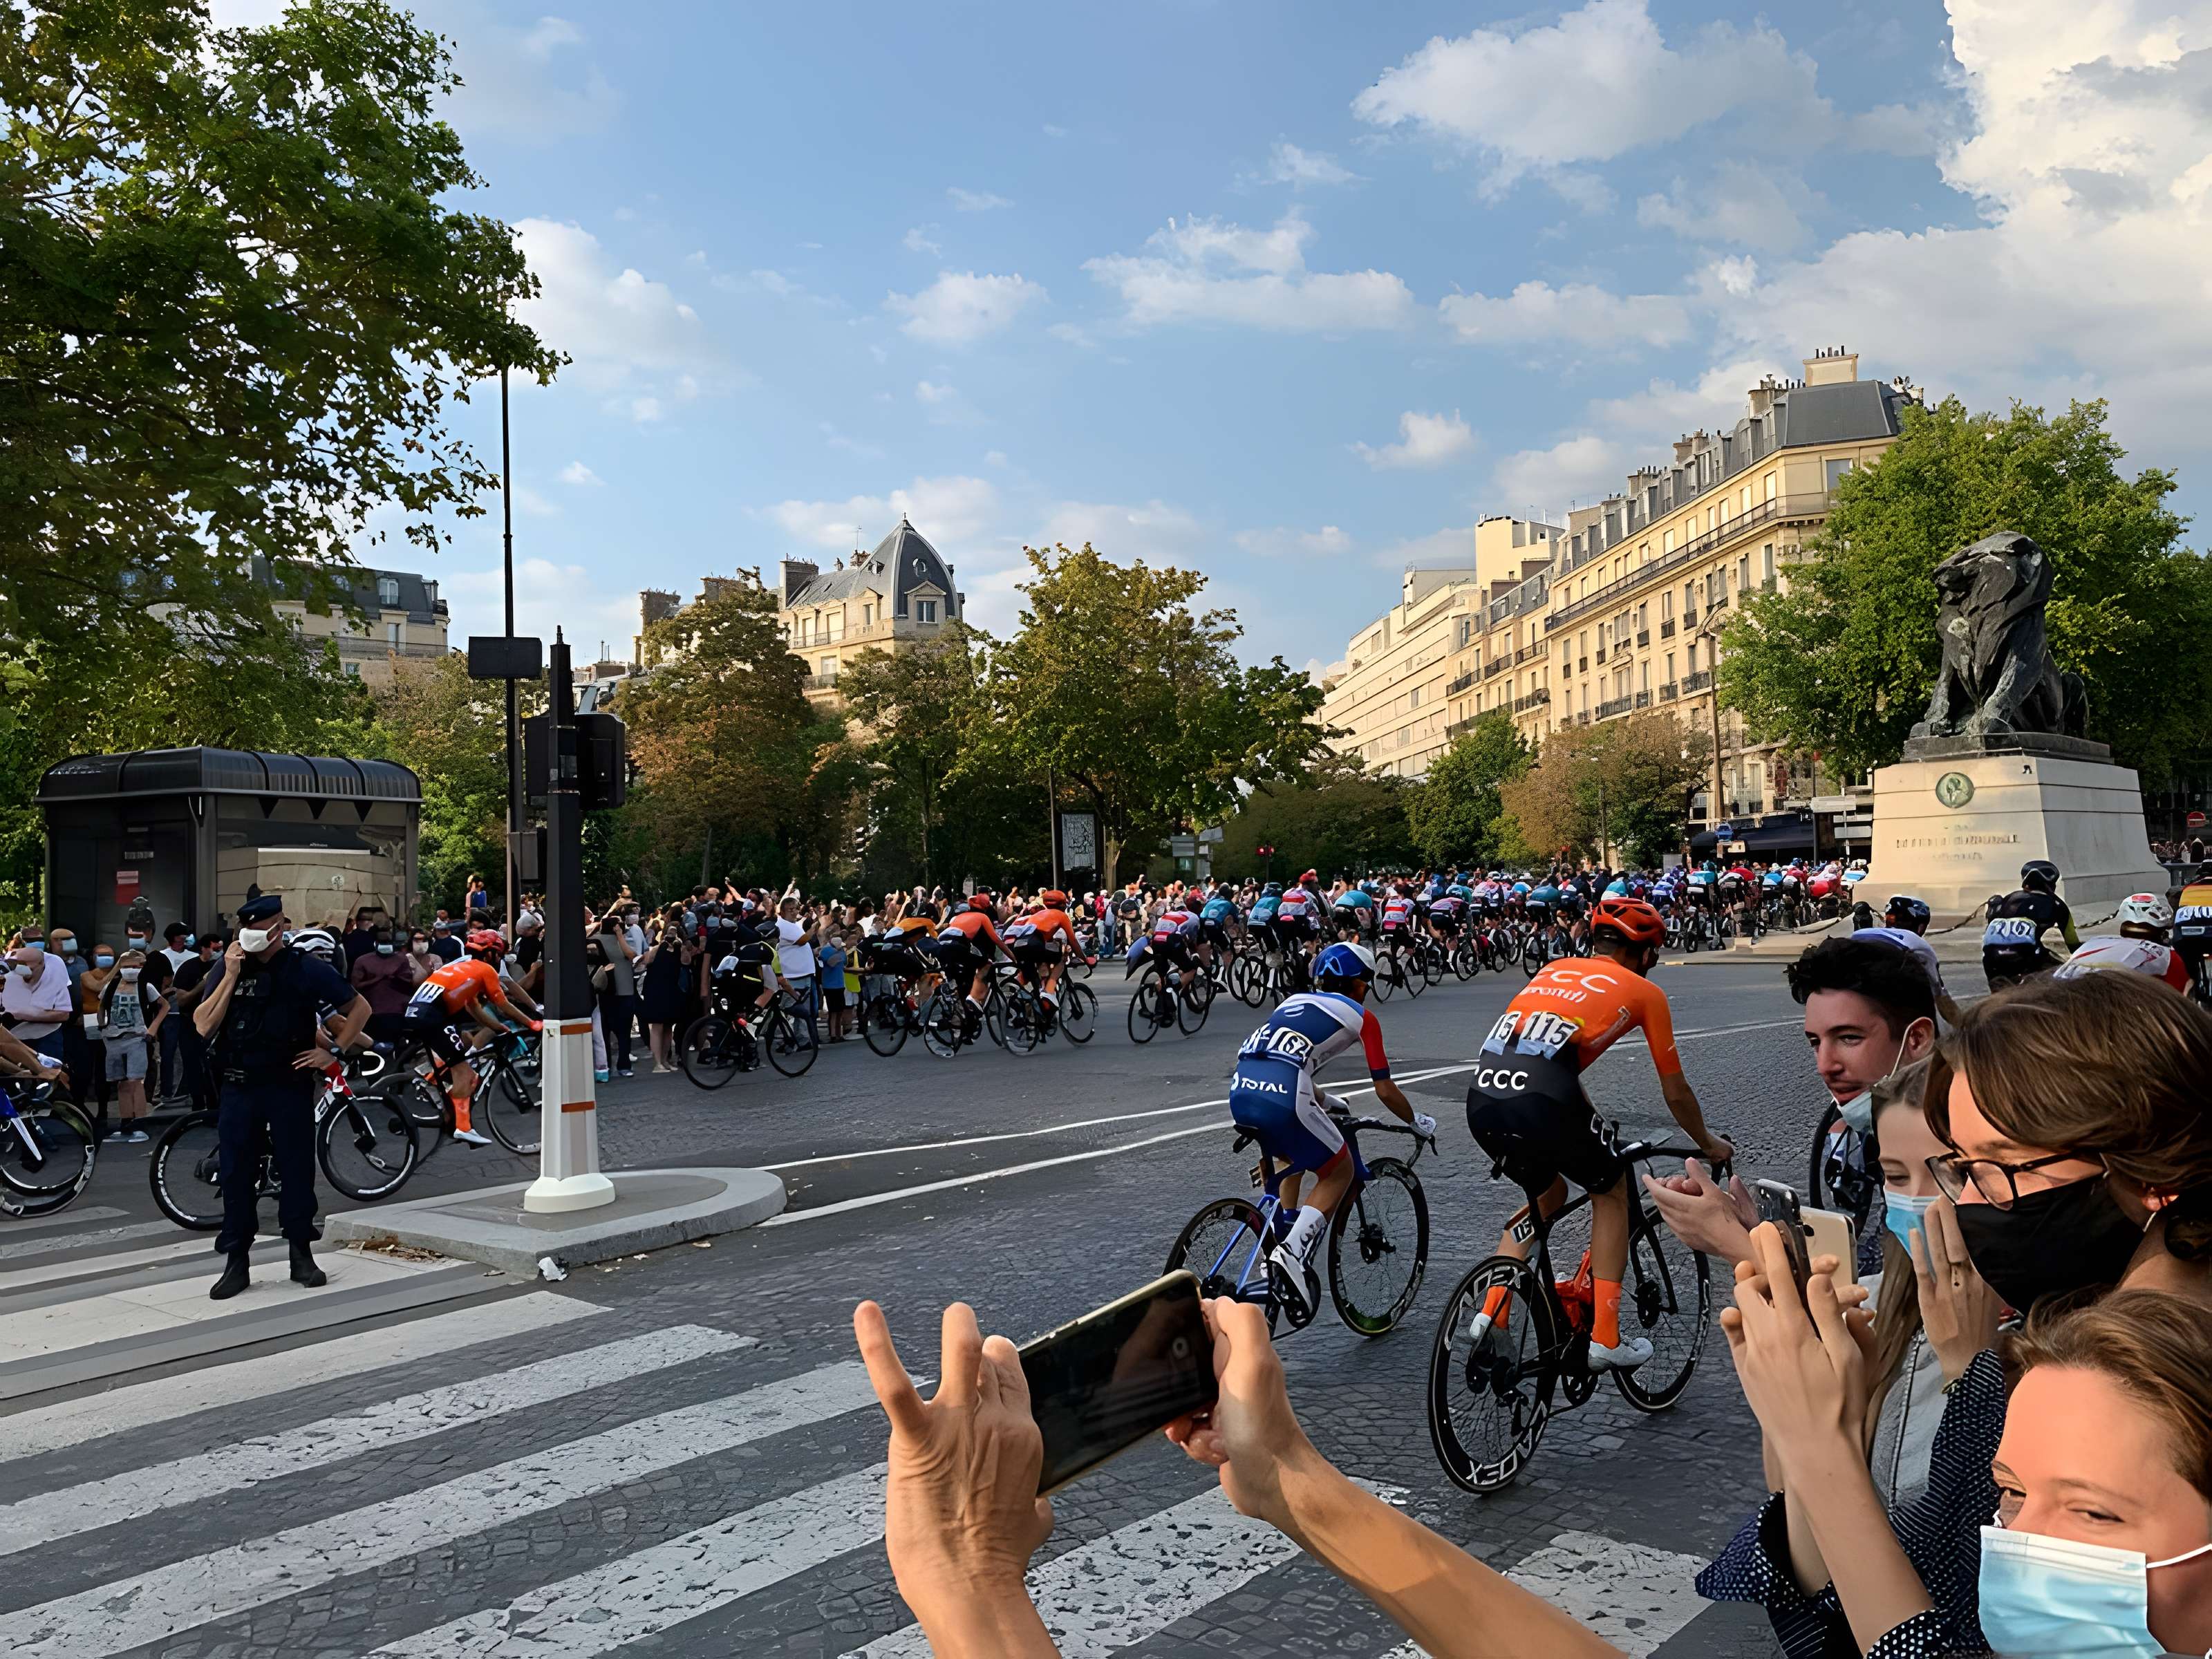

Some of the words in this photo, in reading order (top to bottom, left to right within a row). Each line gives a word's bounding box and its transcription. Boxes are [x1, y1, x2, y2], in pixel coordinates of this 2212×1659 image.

[1523, 1012, 1575, 1045] 115
[1241, 1077, 1288, 1094] TOTAL
[1478, 1069, 1528, 1090] CCC
